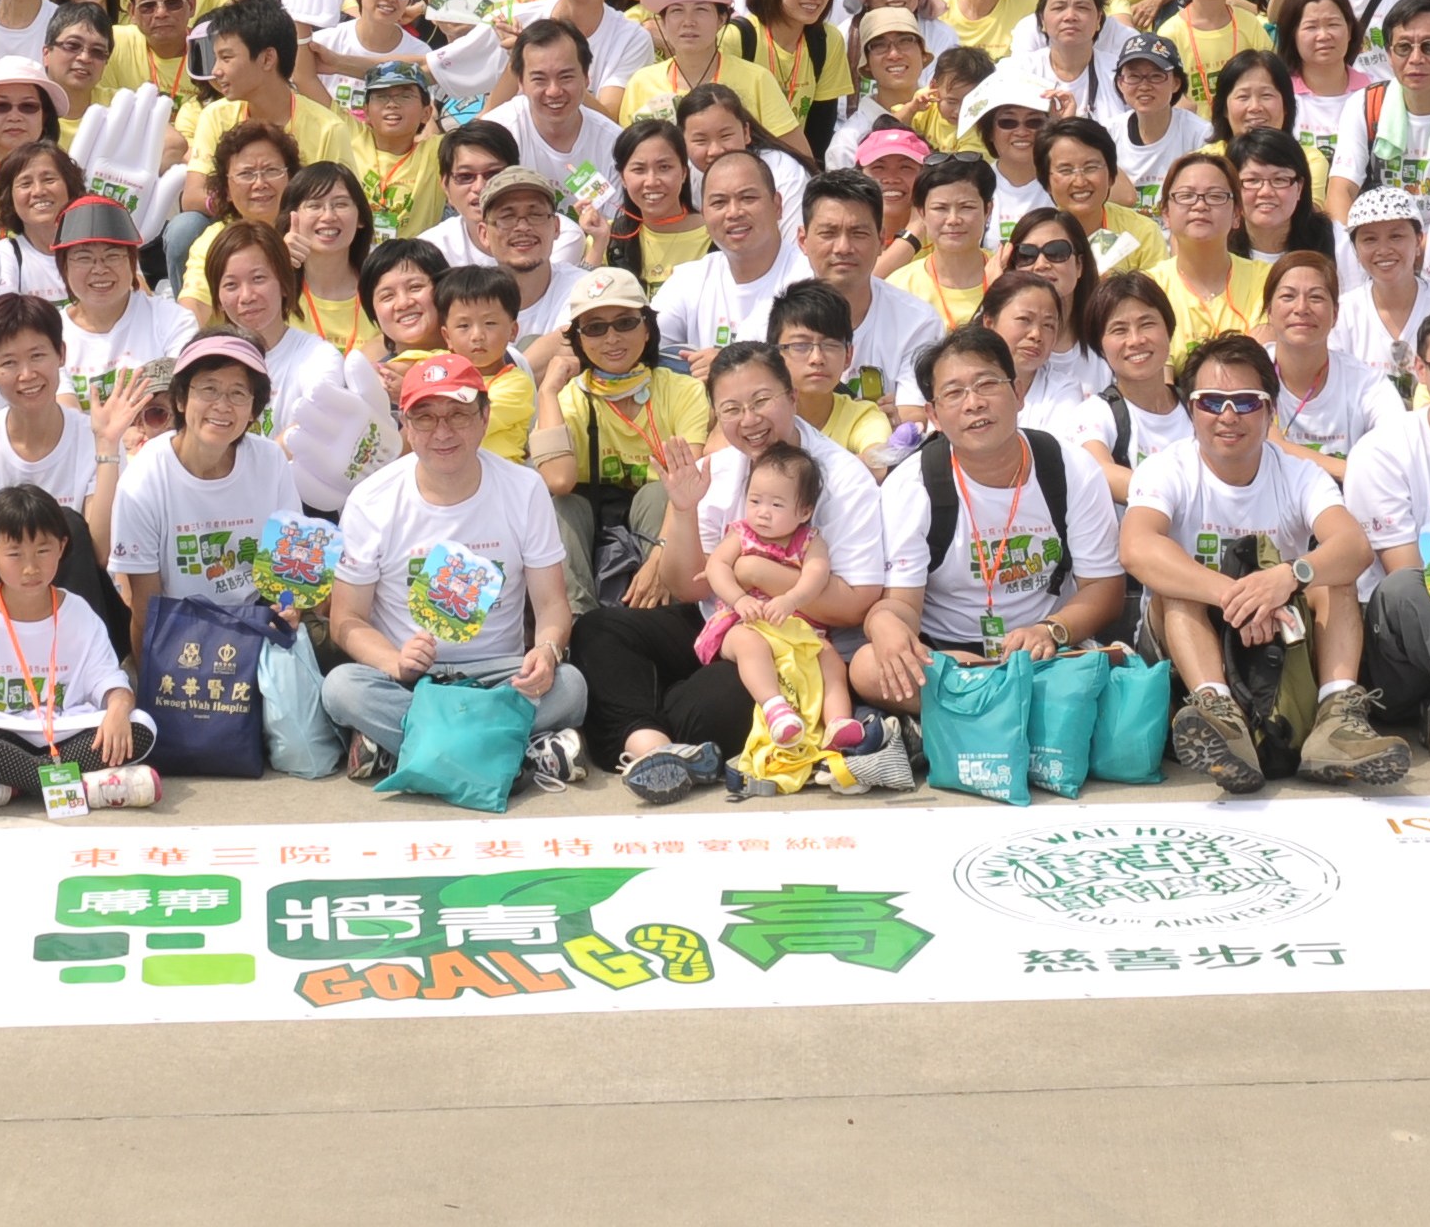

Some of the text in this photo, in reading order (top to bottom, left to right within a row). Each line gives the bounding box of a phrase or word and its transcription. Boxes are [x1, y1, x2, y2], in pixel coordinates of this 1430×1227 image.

[158, 674, 252, 702] 廣華醫院
[155, 695, 252, 715] Kwong Wah Hospital
[1034, 827, 1120, 845] WAH
[1134, 826, 1295, 863] HOSPITAL
[67, 887, 230, 917] 廣華
[1154, 885, 1313, 929] ANNIVERSARY
[1017, 941, 1348, 974] 慈善步行
[294, 950, 577, 1009] GOAL
